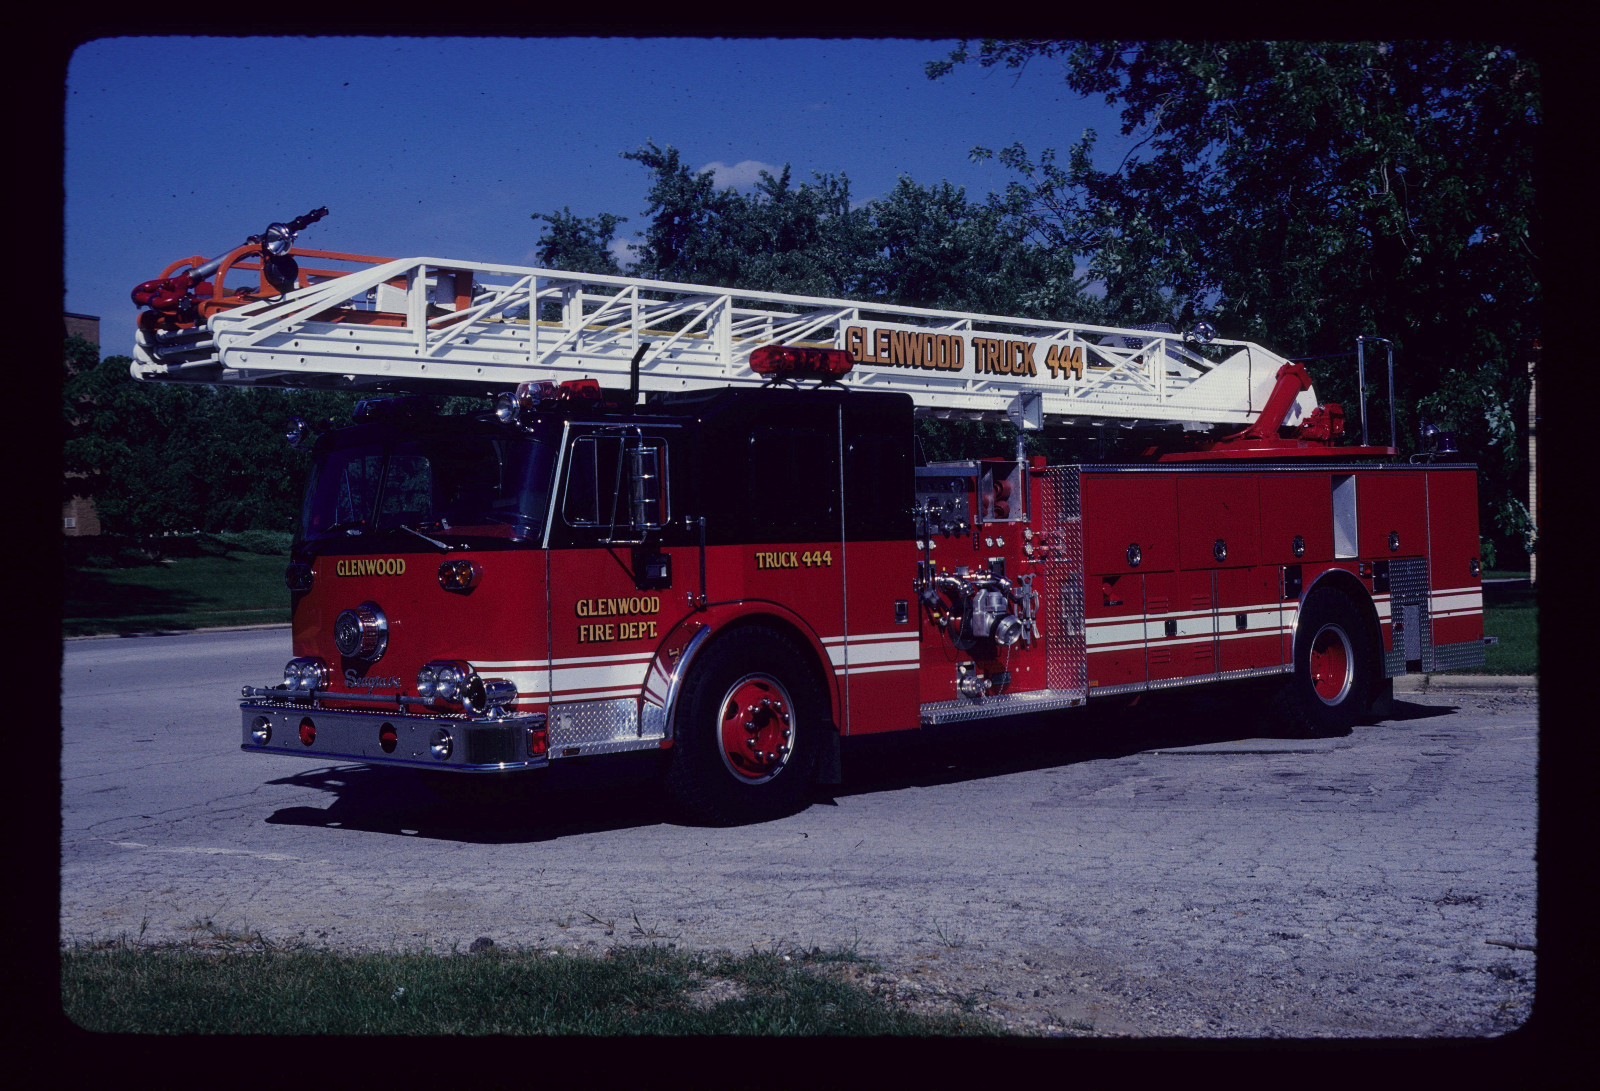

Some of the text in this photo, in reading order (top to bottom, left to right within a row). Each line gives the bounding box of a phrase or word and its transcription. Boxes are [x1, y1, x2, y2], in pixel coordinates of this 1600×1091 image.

[847, 326, 1083, 380] GLENWOOD TRUCK 444
[336, 558, 406, 577] GLENWOOD
[755, 550, 832, 569] TRUCK 444
[575, 596, 660, 618] GLENWOOD
[578, 621, 658, 643] FIRE DEPT.
[344, 668, 402, 695] Seagrave
